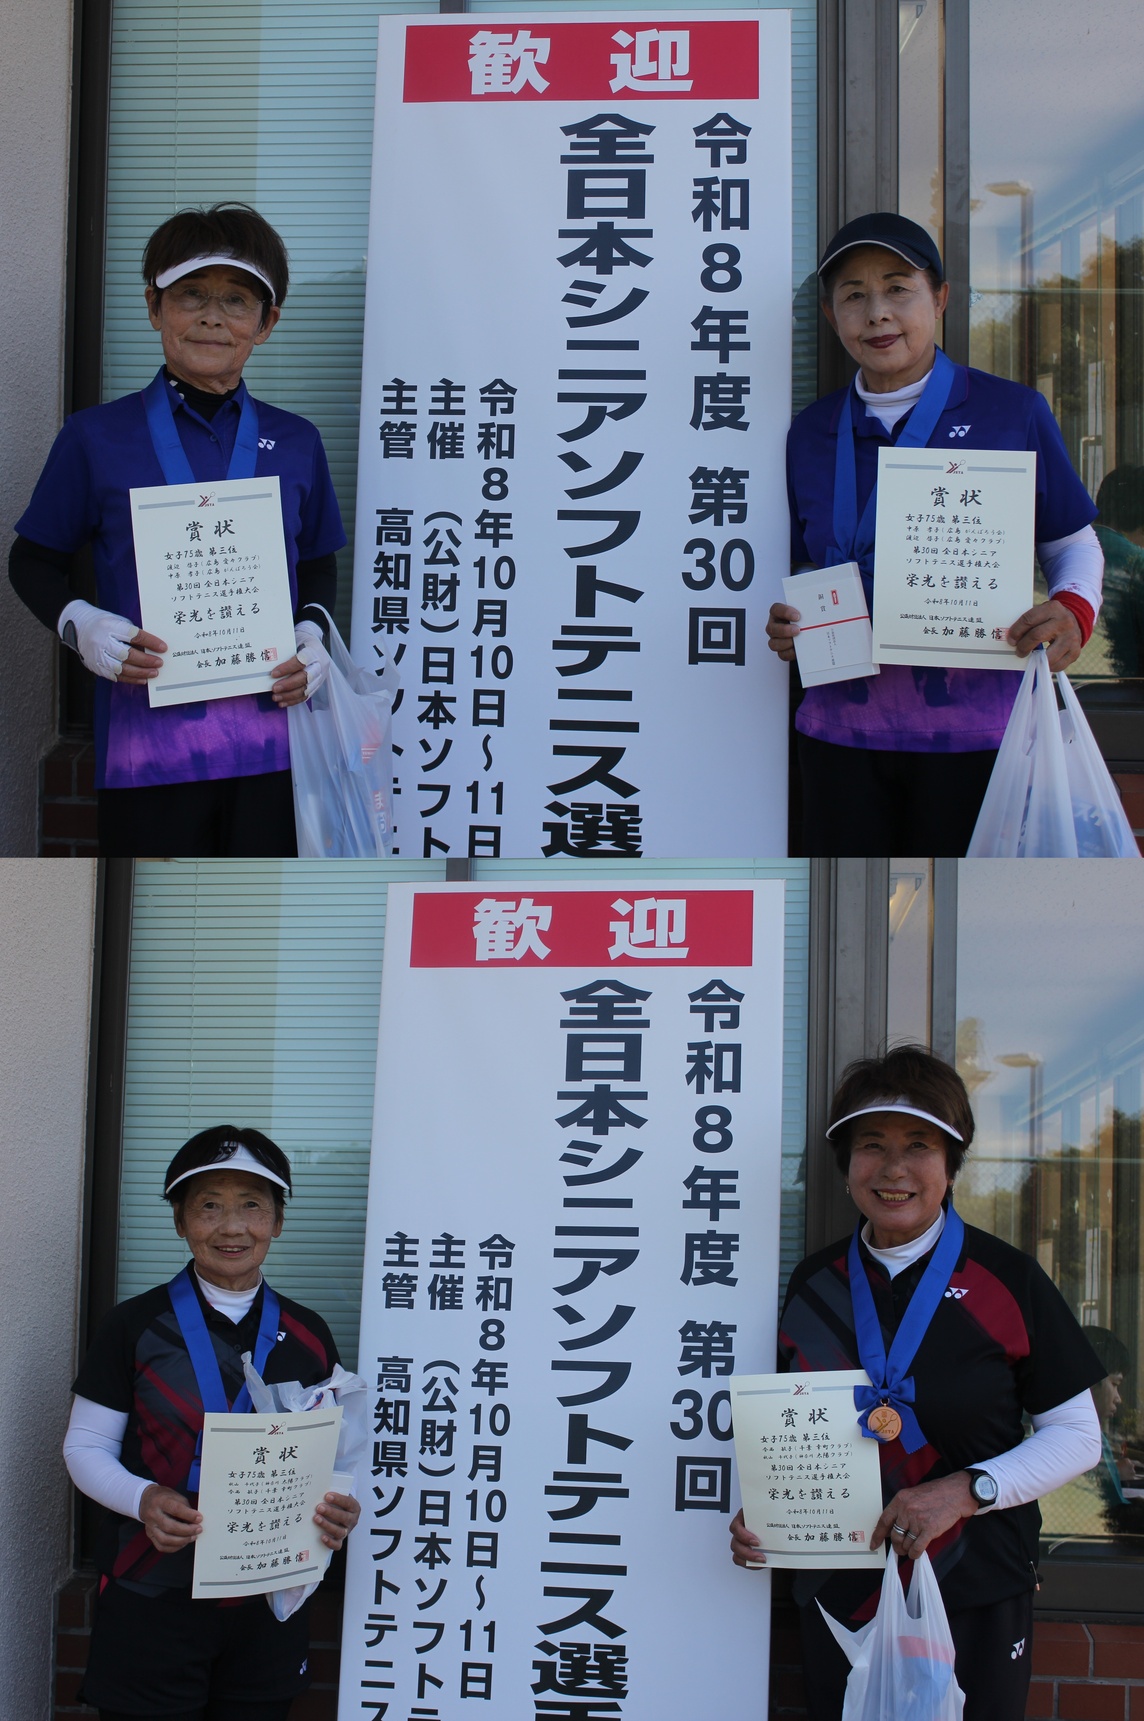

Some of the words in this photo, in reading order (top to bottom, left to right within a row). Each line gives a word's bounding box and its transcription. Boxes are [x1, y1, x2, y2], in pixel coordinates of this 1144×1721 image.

[467, 28, 694, 94] 歓迎
[689, 112, 752, 432] 令和8年度
[379, 378, 418, 460] 主管
[426, 378, 466, 460] 主催
[540, 113, 657, 858] 全日本シニアソフトテニス選
[930, 486, 983, 508] 賞状
[905, 513, 946, 524] 女子75歳
[951, 515, 982, 525] 第三位
[185, 518, 236, 542] 賞状
[164, 548, 204, 561] 女子75歳
[209, 545, 238, 557] 第三位
[913, 545, 939, 555] 第30回
[942, 547, 997, 557] 全日本シニア
[681, 466, 756, 667] 第30回
[906, 558, 1001, 569] ソフトテニス選手権大会
[171, 586, 260, 602] ソフトテニス選手権大会
[176, 581, 201, 592] 第30回
[204, 576, 255, 588] 全日本シニア
[923, 598, 979, 607] 令和8年10月11日
[472, 897, 690, 961] 歓迎
[679, 979, 746, 1287] 令和8年度
[381, 1231, 420, 1310] 主管
[426, 1232, 466, 1311] 主催
[669, 1320, 738, 1514] 第30回
[781, 1407, 830, 1428] 賞状
[760, 1434, 797, 1443] 女子75歳
[802, 1432, 831, 1442] 第三位
[252, 1445, 299, 1465] 賞状
[228, 1470, 266, 1479] 女子75歳
[270, 1467, 296, 1478] 第三位
[765, 1472, 851, 1481] ソフトテニス選手権大会
[771, 1463, 794, 1472] 第30回
[796, 1462, 847, 1471] 全日本シニア
[234, 1498, 258, 1506] 第30回
[260, 1491, 305, 1505] 全日本シニア
